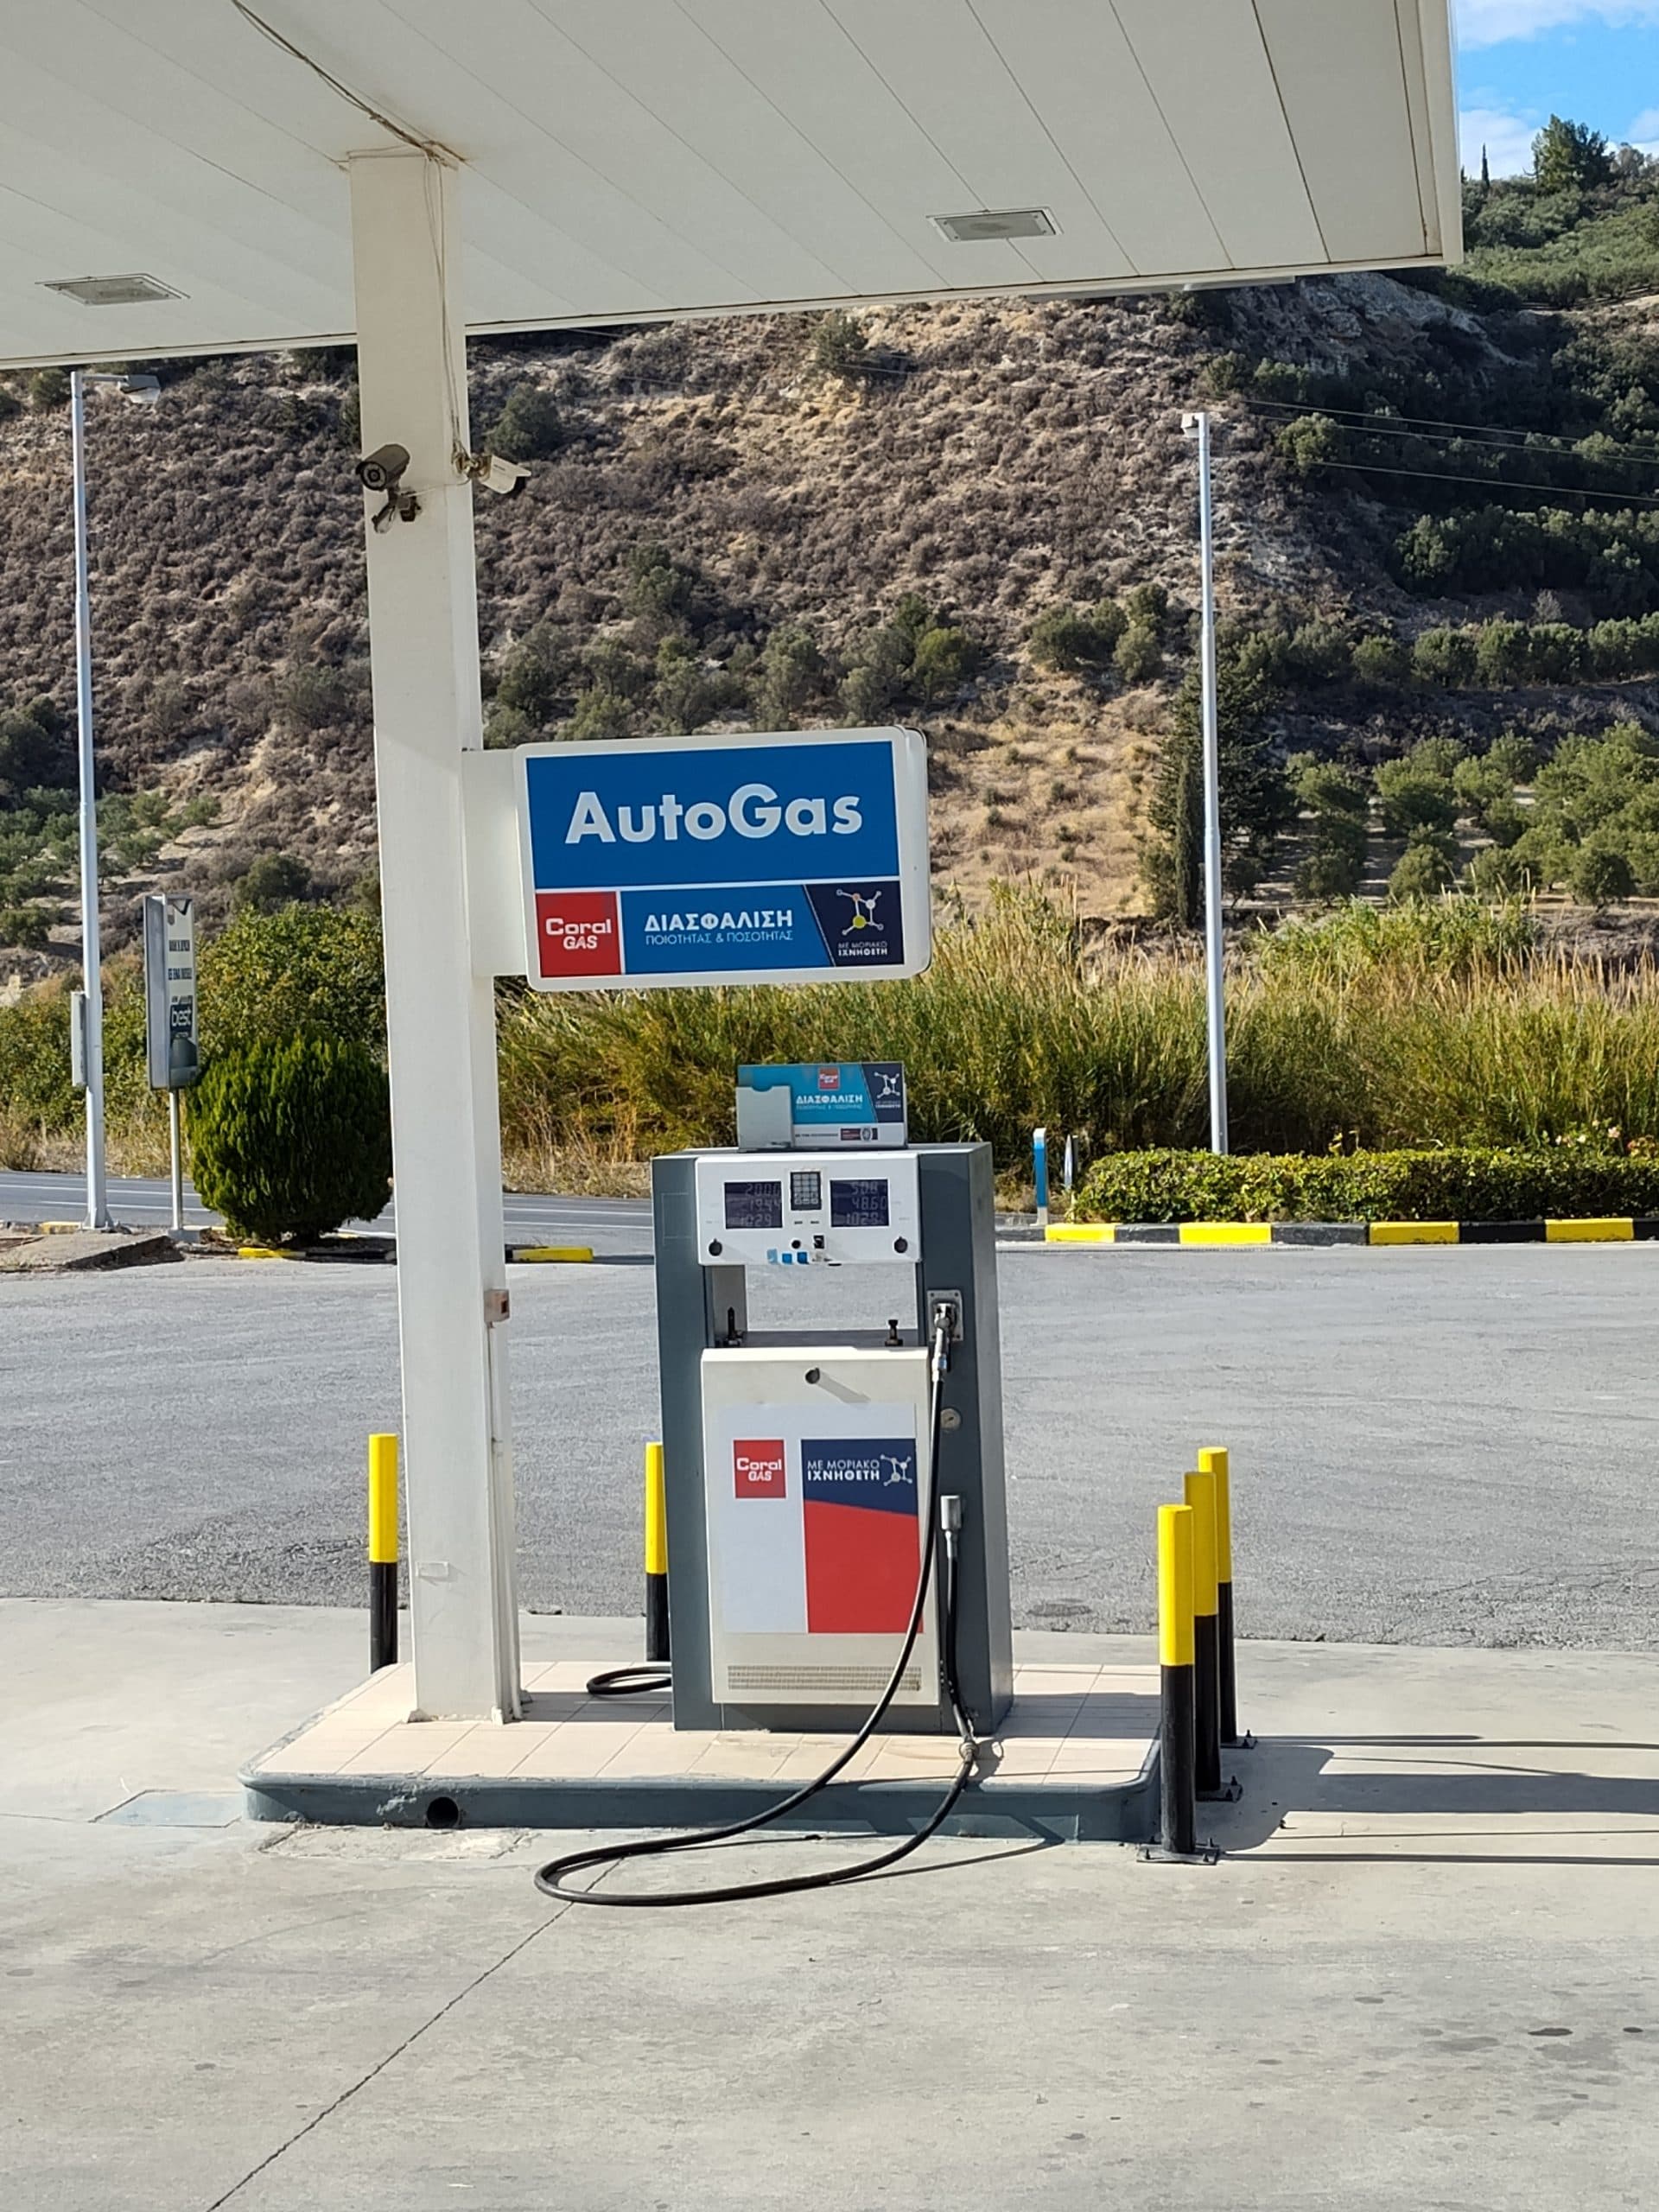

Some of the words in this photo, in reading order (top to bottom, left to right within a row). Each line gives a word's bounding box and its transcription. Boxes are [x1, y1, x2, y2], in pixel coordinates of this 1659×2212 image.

[565, 783, 863, 844] AutoGas
[545, 917, 612, 937] Coral
[644, 909, 793, 932] ΔΙΑΣΦΑΛΙΣΗ
[563, 935, 598, 950] GAS
[715, 933, 724, 944] &
[736, 1457, 782, 1472] Coral
[807, 1460, 824, 1471] ΜΕ
[826, 1459, 880, 1470] ΜΟΡΙΑΚΟ
[747, 1470, 772, 1482] GAS
[807, 1469, 880, 1482] ΙΧΝΗΘΕΤΗ
